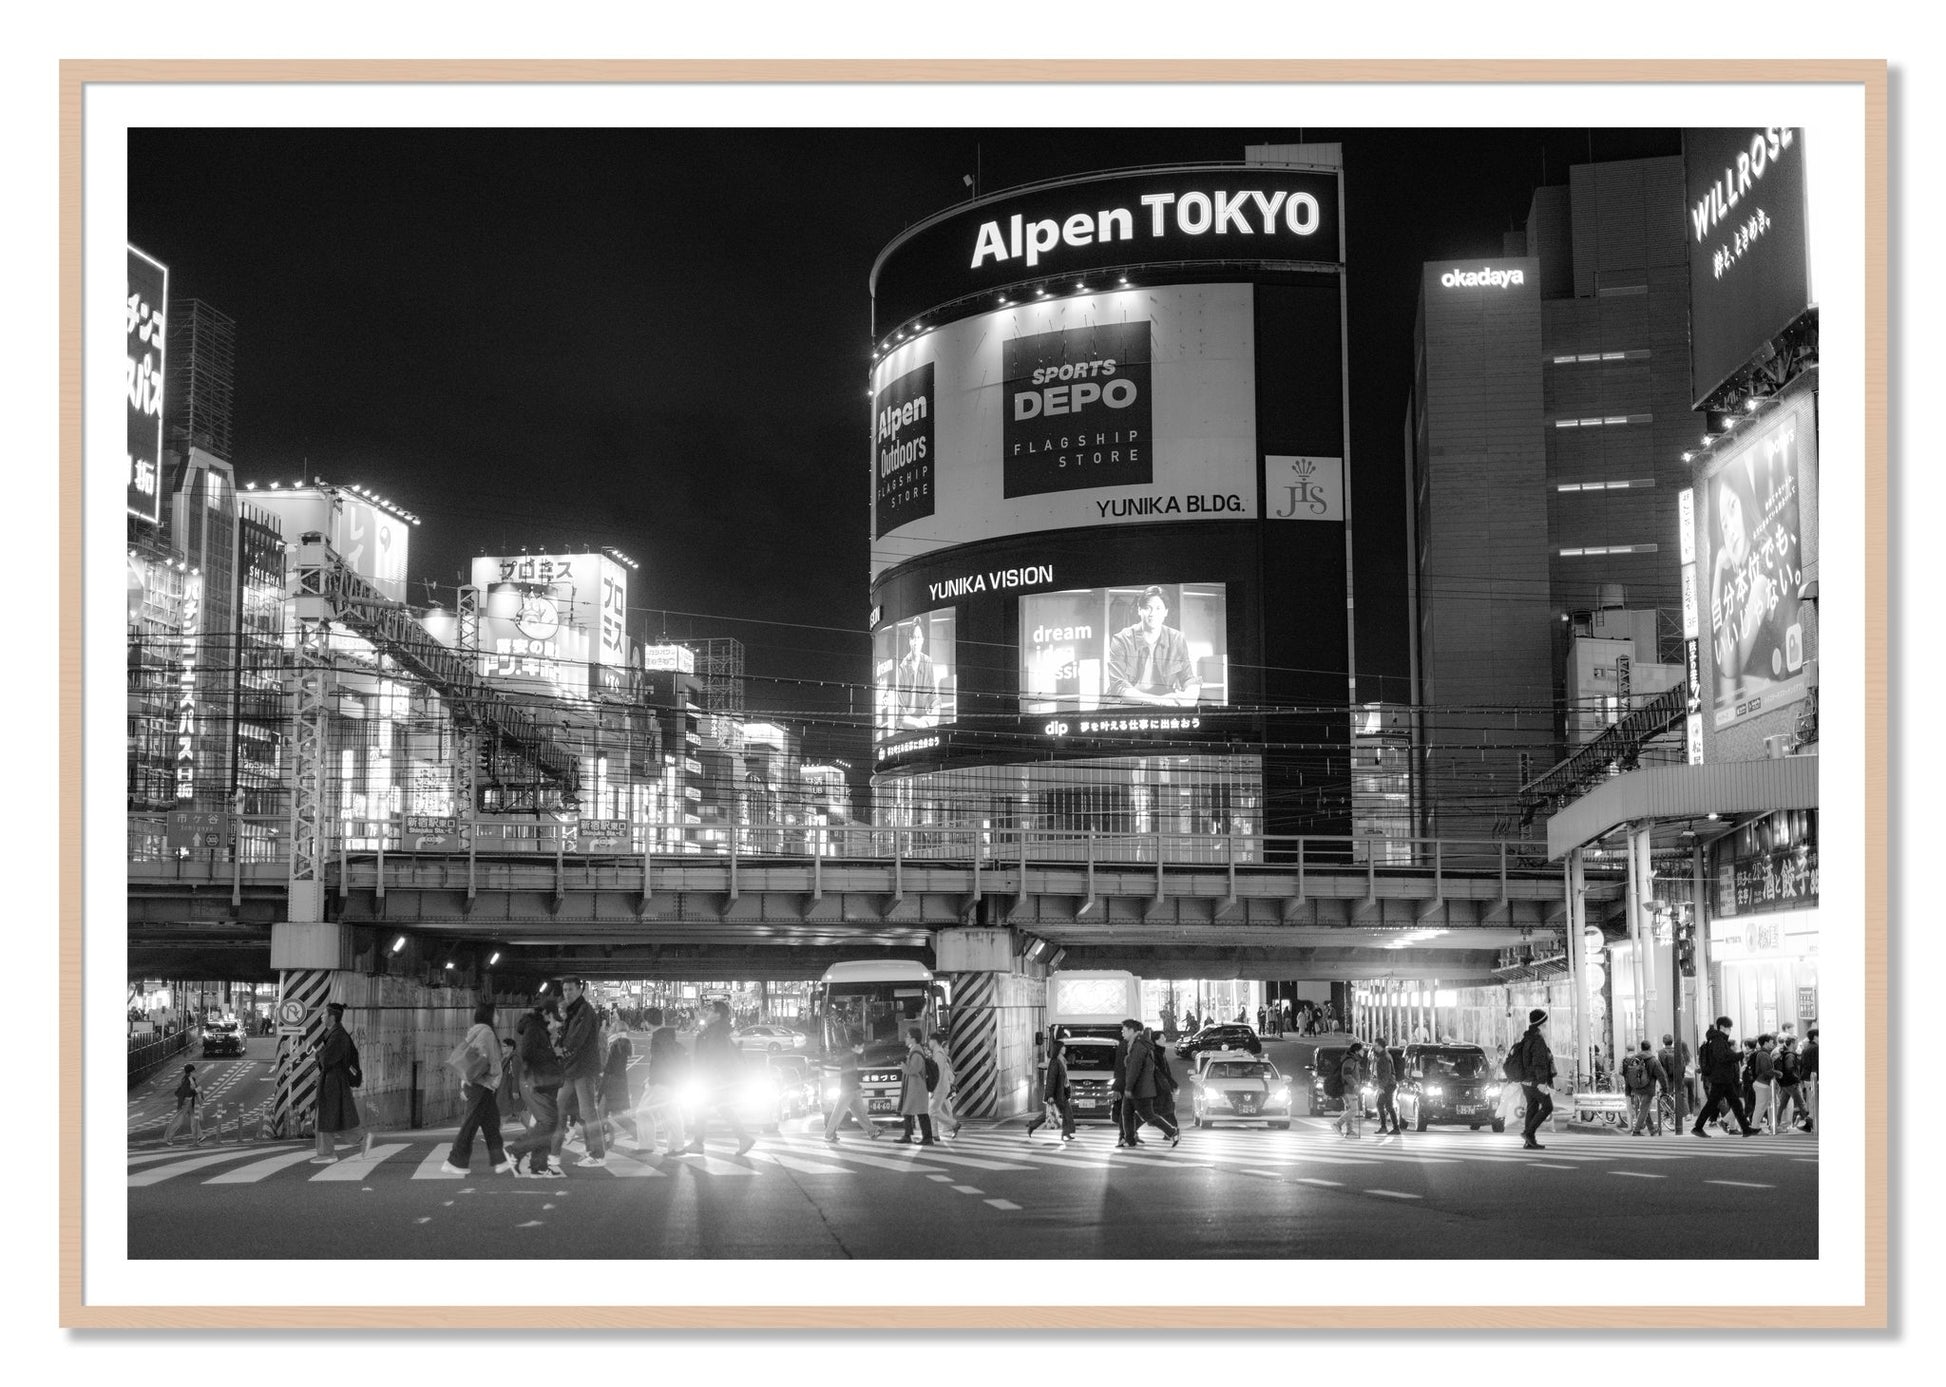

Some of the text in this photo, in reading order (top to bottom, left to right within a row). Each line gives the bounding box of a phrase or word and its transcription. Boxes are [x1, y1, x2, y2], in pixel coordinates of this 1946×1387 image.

[1692, 127, 1793, 243] WILLROSE
[971, 190, 1320, 269] Alpen TOKYO
[1440, 267, 1525, 289] okadaya
[1031, 358, 1117, 385] SPORTS
[1014, 378, 1138, 421] DEPO
[878, 395, 927, 444] Alpen
[1014, 430, 1138, 456] FLAGSHIP
[881, 436, 927, 479] Outdoors
[1058, 449, 1138, 468] STORE
[878, 465, 928, 501] FLAGSHIP
[891, 483, 928, 508] STORE
[1096, 494, 1246, 518] YUNIKA BLDG.
[249, 565, 280, 588] SHISHA
[928, 564, 1054, 602] YUNIKA VISION
[1033, 624, 1092, 643] dream
[1045, 718, 1200, 737] dip 夢を叶える仕事に出会おう
